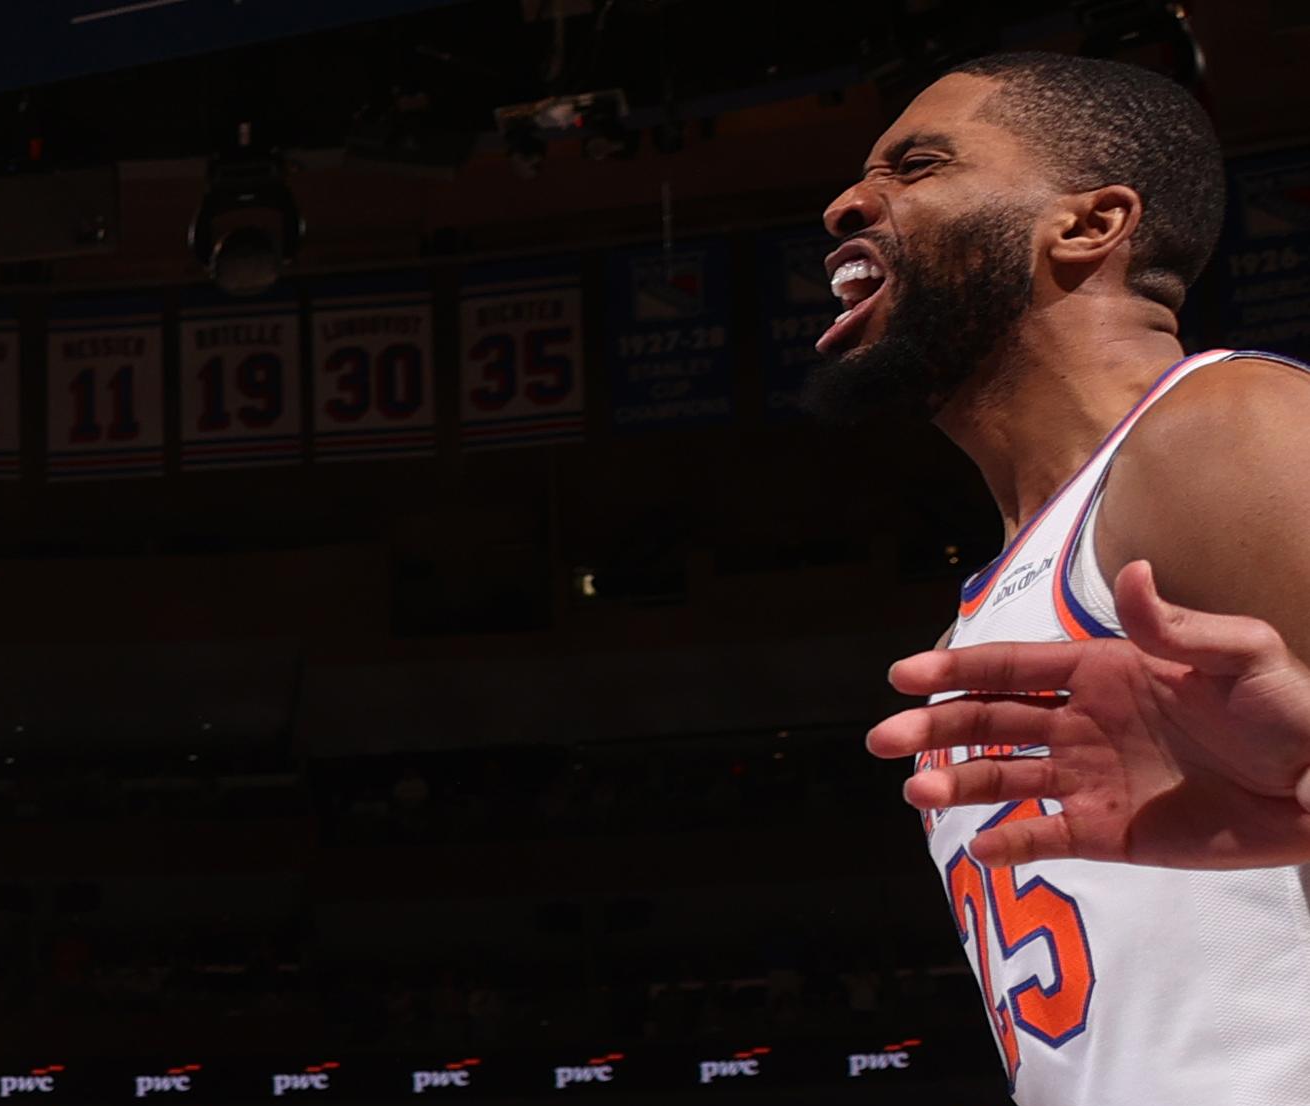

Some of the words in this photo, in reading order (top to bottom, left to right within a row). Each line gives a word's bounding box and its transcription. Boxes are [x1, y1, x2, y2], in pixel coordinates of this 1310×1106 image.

[324, 342, 423, 422] 30
[468, 326, 572, 411] 35
[68, 365, 140, 443] 11
[196, 352, 283, 432] 19
[553, 1063, 615, 1089] pwc
[697, 1057, 762, 1084] pwc
[847, 1049, 912, 1078] pwc
[134, 1073, 192, 1097] pwc
[271, 1071, 329, 1096] pwc
[411, 1069, 471, 1093] pwc
